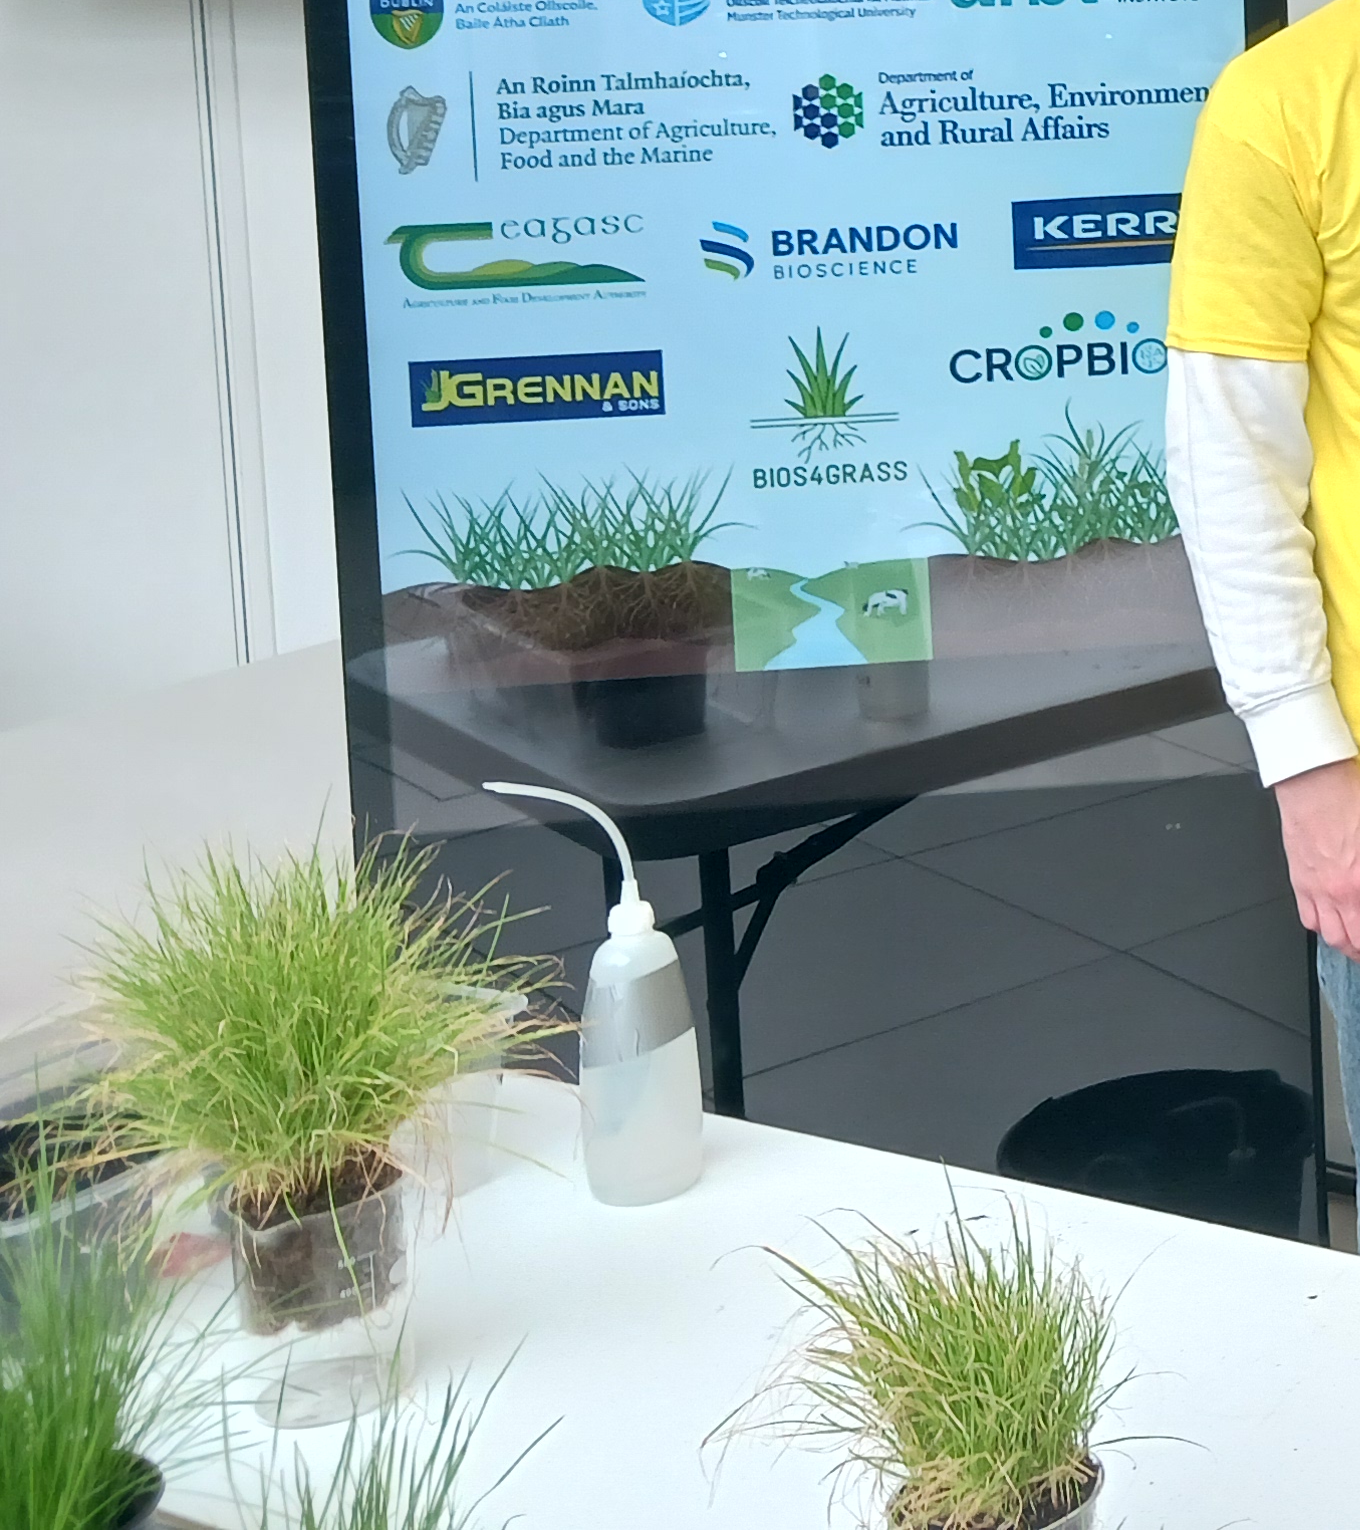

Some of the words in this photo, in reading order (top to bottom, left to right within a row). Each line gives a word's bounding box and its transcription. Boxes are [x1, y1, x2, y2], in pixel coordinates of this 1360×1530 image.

[455, 3, 474, 14] An
[497, 77, 525, 95] An
[531, 75, 595, 95] Roinn
[600, 70, 750, 92] Talmhaíochta,
[878, 71, 957, 85] Department
[961, 69, 974, 81] of
[497, 101, 531, 120] Bia
[536, 103, 586, 121] agus
[591, 99, 644, 116] Mara
[878, 87, 1040, 121] Agriculture,
[1048, 83, 1210, 108] Environmen
[500, 125, 623, 149] Department
[628, 122, 652, 139] of
[655, 119, 776, 143] Agriculture,
[880, 122, 930, 146] and
[939, 118, 1015, 145] Rural
[1021, 116, 1110, 141] Affairs
[501, 149, 553, 169] Food
[558, 148, 596, 167] and
[602, 147, 635, 165] the
[640, 145, 713, 164] Marine
[1033, 210, 1179, 240] KERR
[772, 222, 958, 256] BRANDON
[774, 260, 917, 279] BIOSCIENCE
[950, 338, 1168, 383] CROPBIO
[602, 401, 613, 412] &
[618, 399, 660, 411] SONS
[753, 461, 908, 489] BIOS4GRASS
